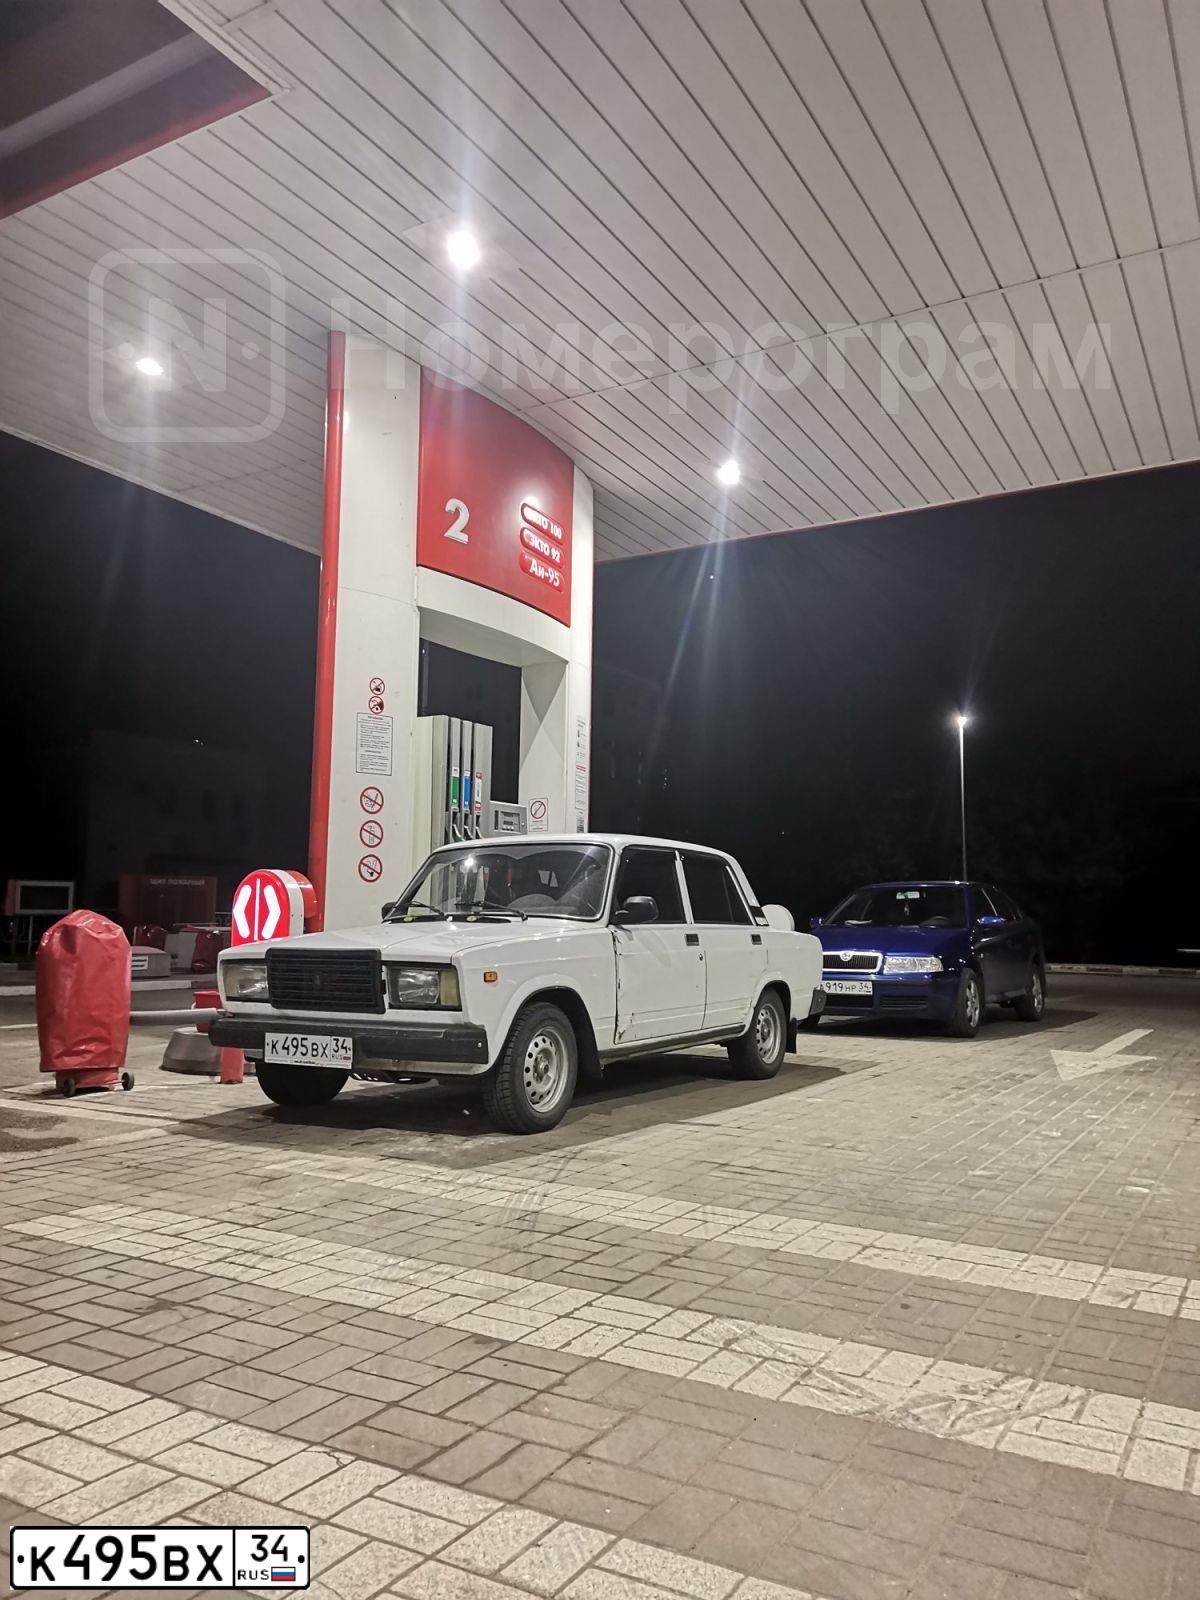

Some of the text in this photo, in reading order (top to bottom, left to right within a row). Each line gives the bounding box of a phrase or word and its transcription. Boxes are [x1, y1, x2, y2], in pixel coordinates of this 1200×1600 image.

[444, 498, 470, 544] 2
[550, 521, 562, 540] 100
[529, 535, 561, 563] ЭКТО 92
[859, 982, 869, 991] 34
[271, 1036, 348, 1058] К495ВХ 34
